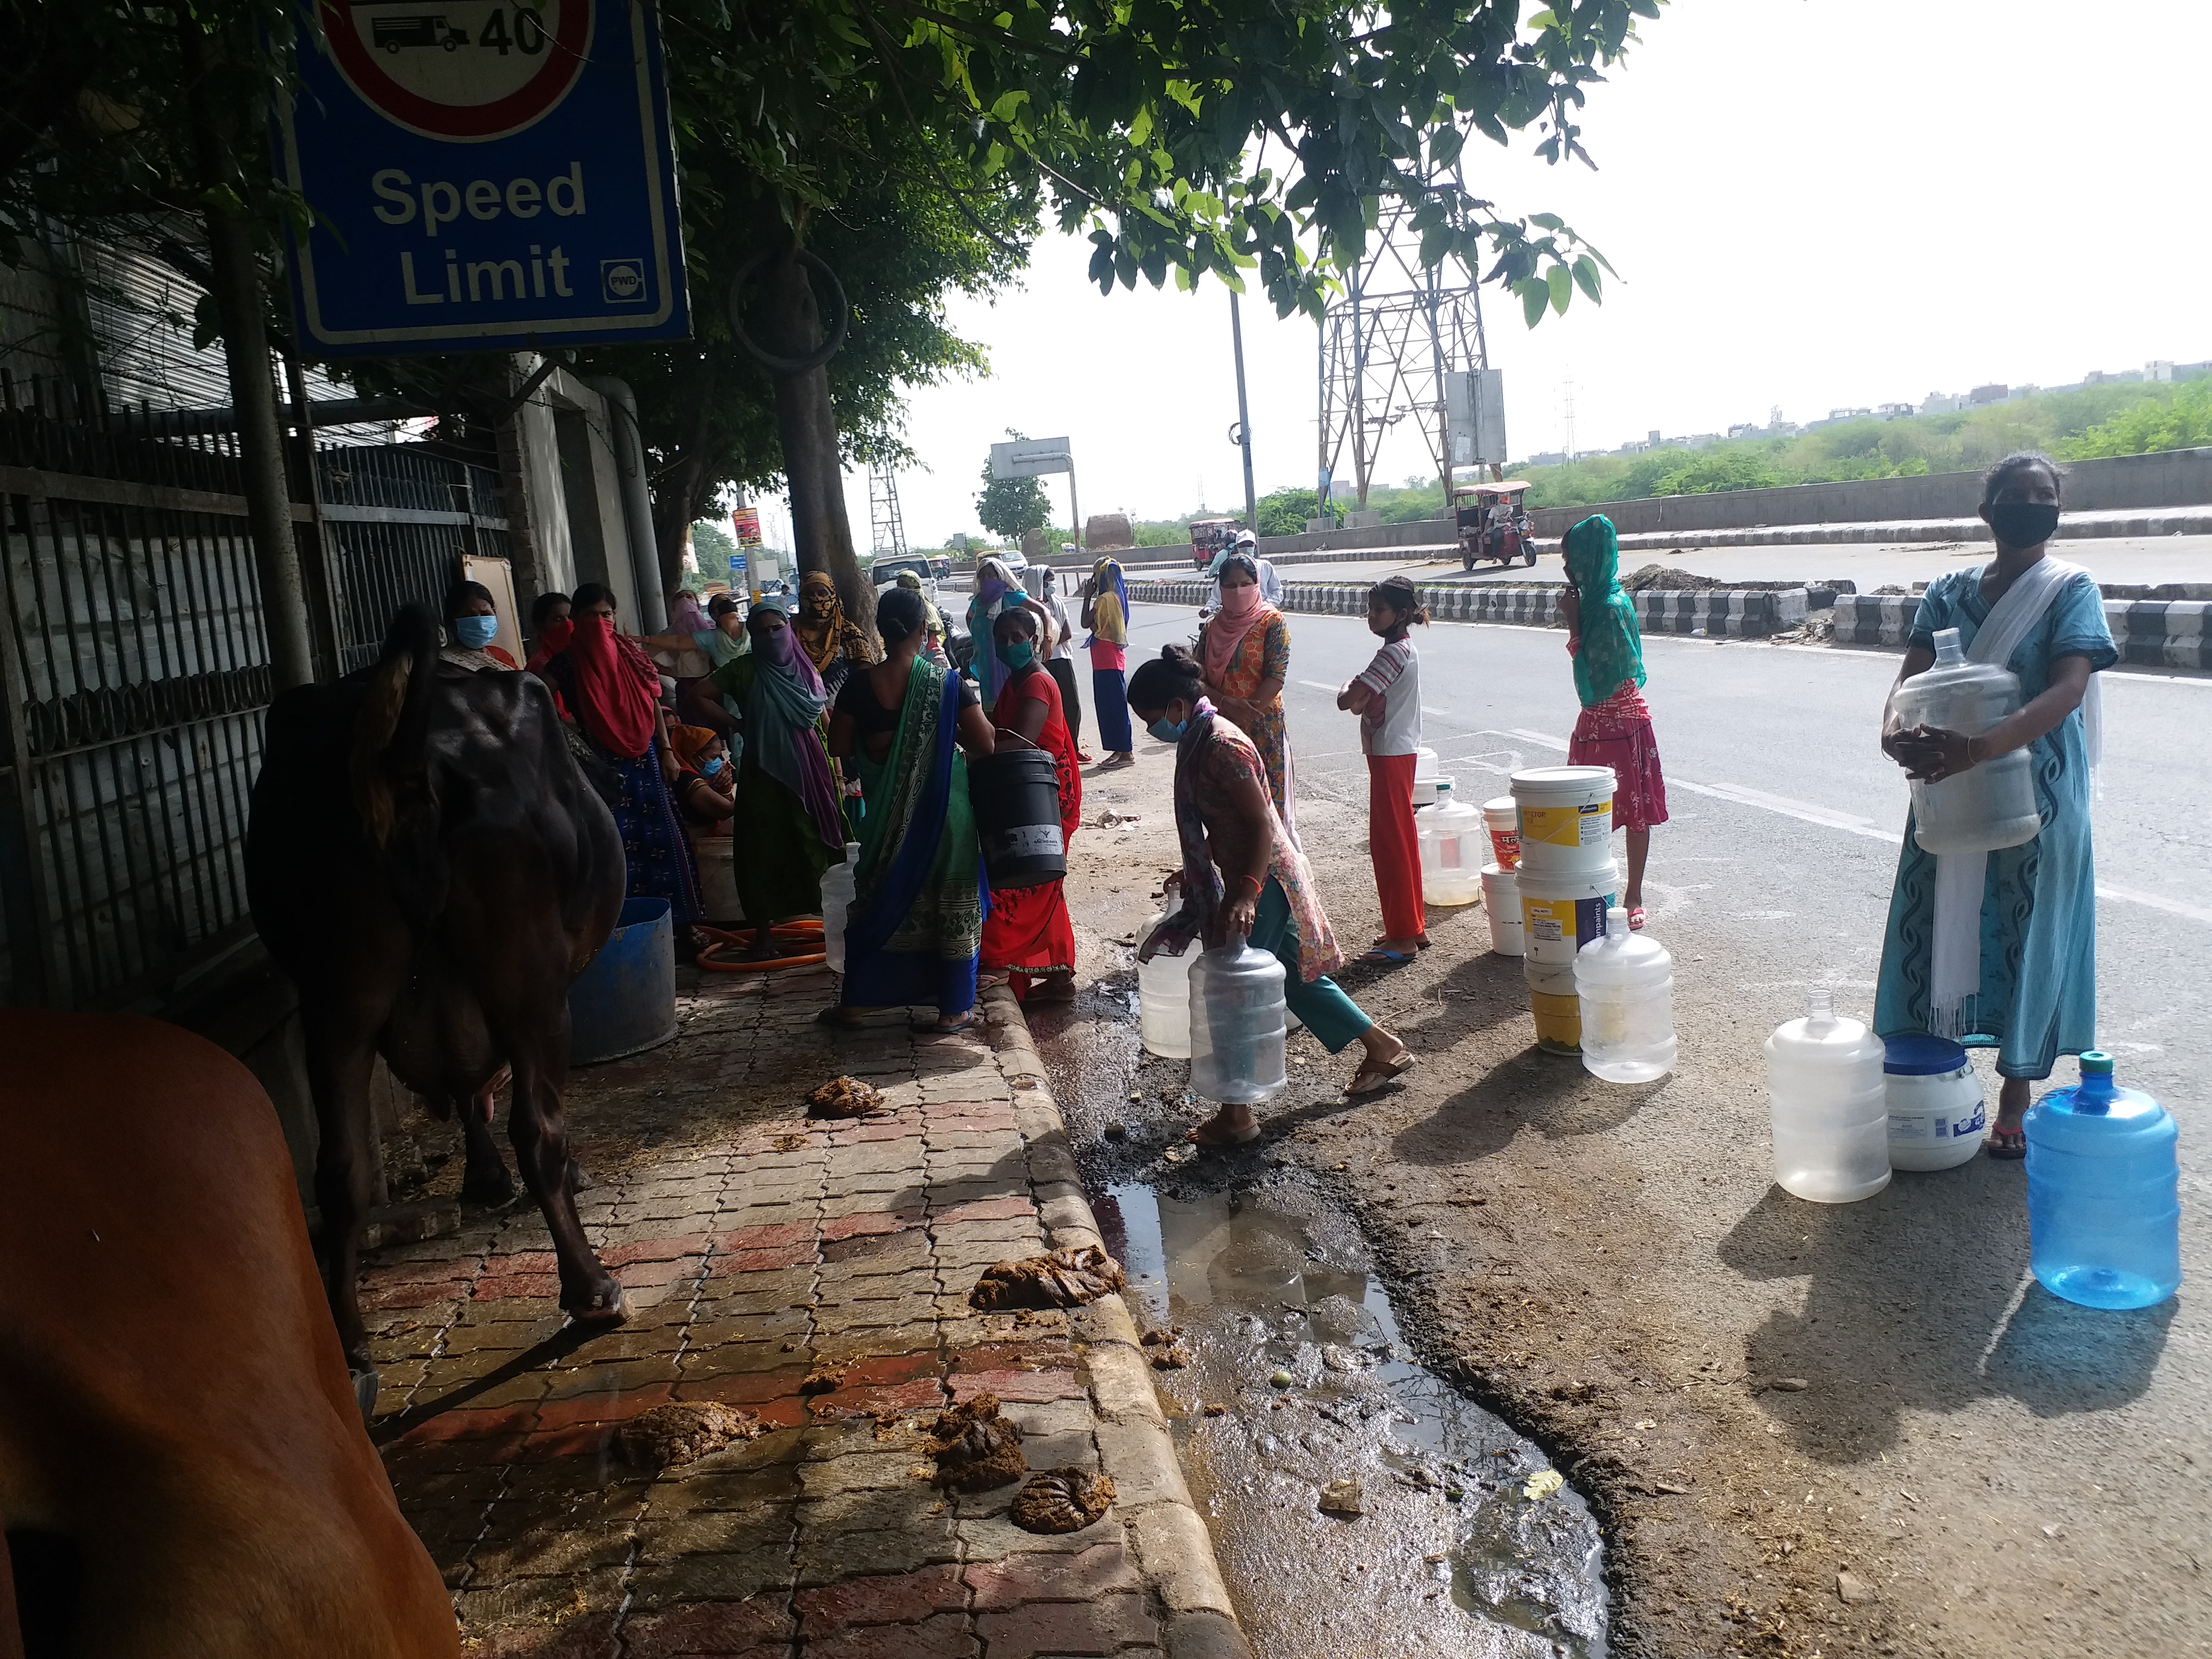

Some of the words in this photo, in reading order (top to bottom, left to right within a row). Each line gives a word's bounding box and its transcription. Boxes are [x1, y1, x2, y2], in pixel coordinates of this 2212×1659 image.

[480, 8, 544, 56] 40
[372, 162, 586, 237] Speed
[401, 245, 574, 304] Limit
[611, 276, 636, 286] PWD
[1593, 902, 1603, 938] anpaints
